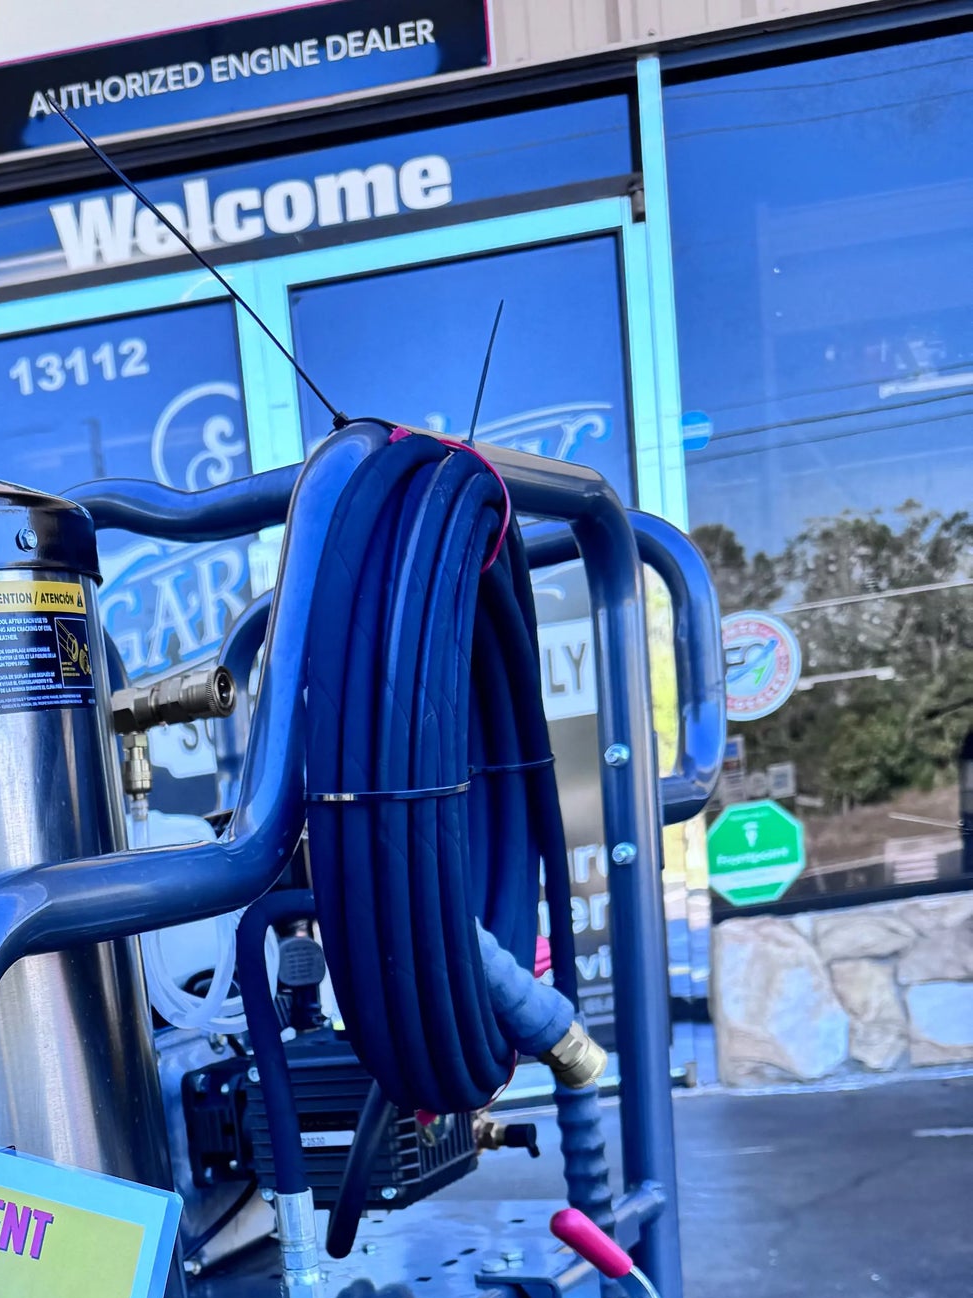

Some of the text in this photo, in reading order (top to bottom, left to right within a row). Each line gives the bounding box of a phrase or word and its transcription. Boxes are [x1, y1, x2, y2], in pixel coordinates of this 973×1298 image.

[29, 19, 435, 118] AUTHORIZED ENGINE DEALER
[49, 155, 452, 271] Welcome
[9, 338, 149, 396] 13112
[41, 592, 74, 604] ATENCIÓN
